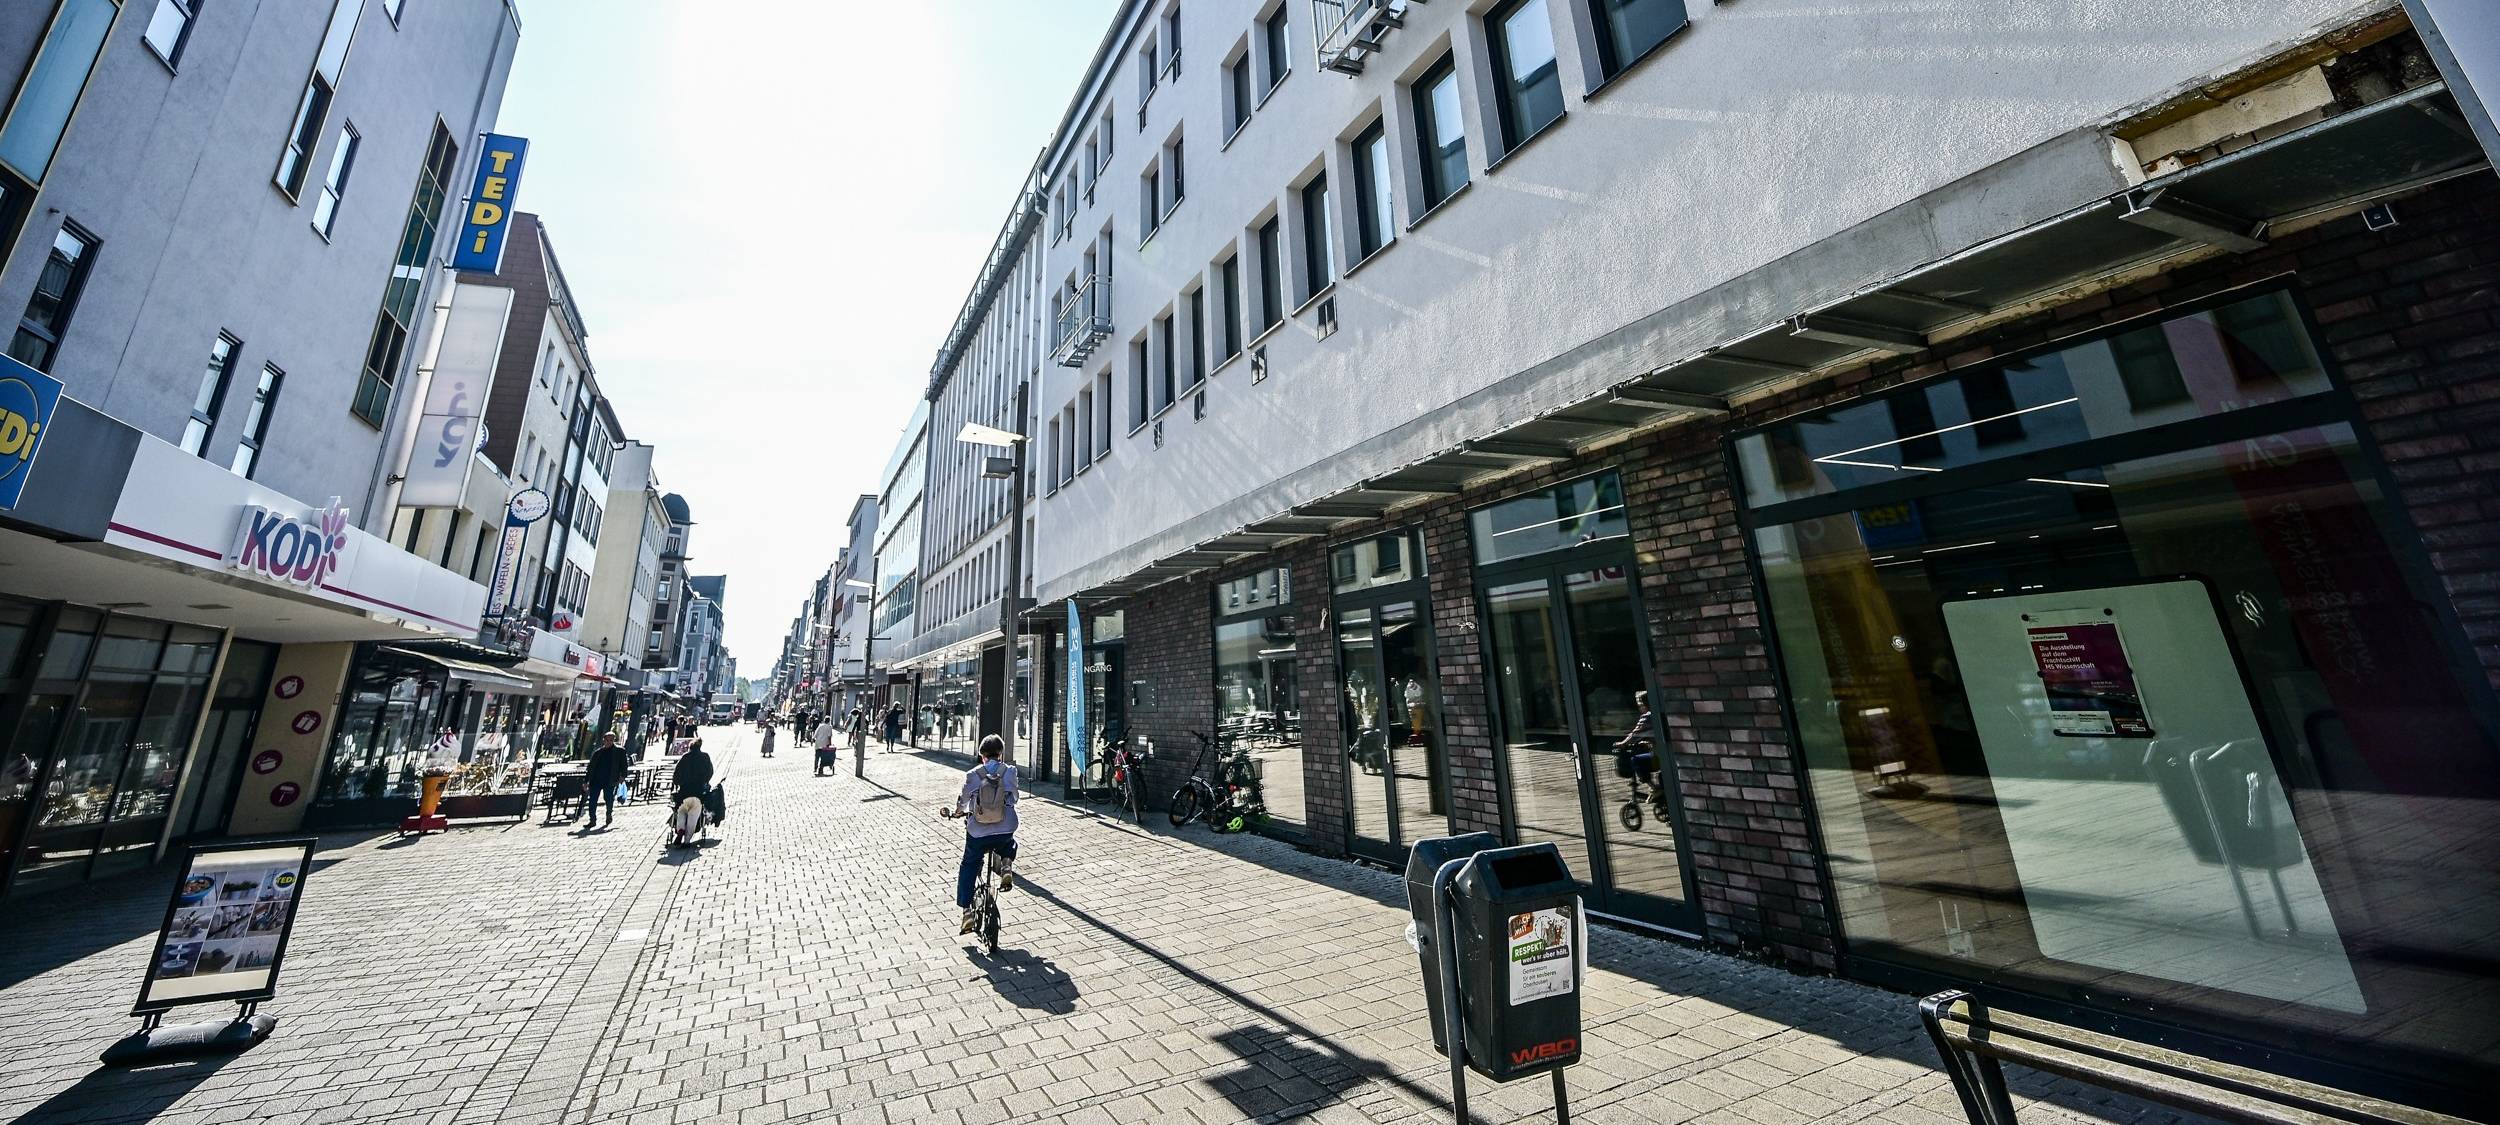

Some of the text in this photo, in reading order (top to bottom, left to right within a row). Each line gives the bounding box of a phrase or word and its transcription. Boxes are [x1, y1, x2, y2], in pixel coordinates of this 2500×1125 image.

[470, 150, 516, 254] TEDi
[240, 510, 334, 586] KODi
[496, 562, 510, 598] WAFFELN
[491, 602, 502, 615] EIS
[2050, 643, 2085, 652] Ausstellung
[2043, 656, 2081, 664] Frachtschiff
[2056, 662, 2095, 670] Wissenschaft
[1084, 664, 1112, 673] NGANG
[1510, 1039, 1577, 1064] WBO
